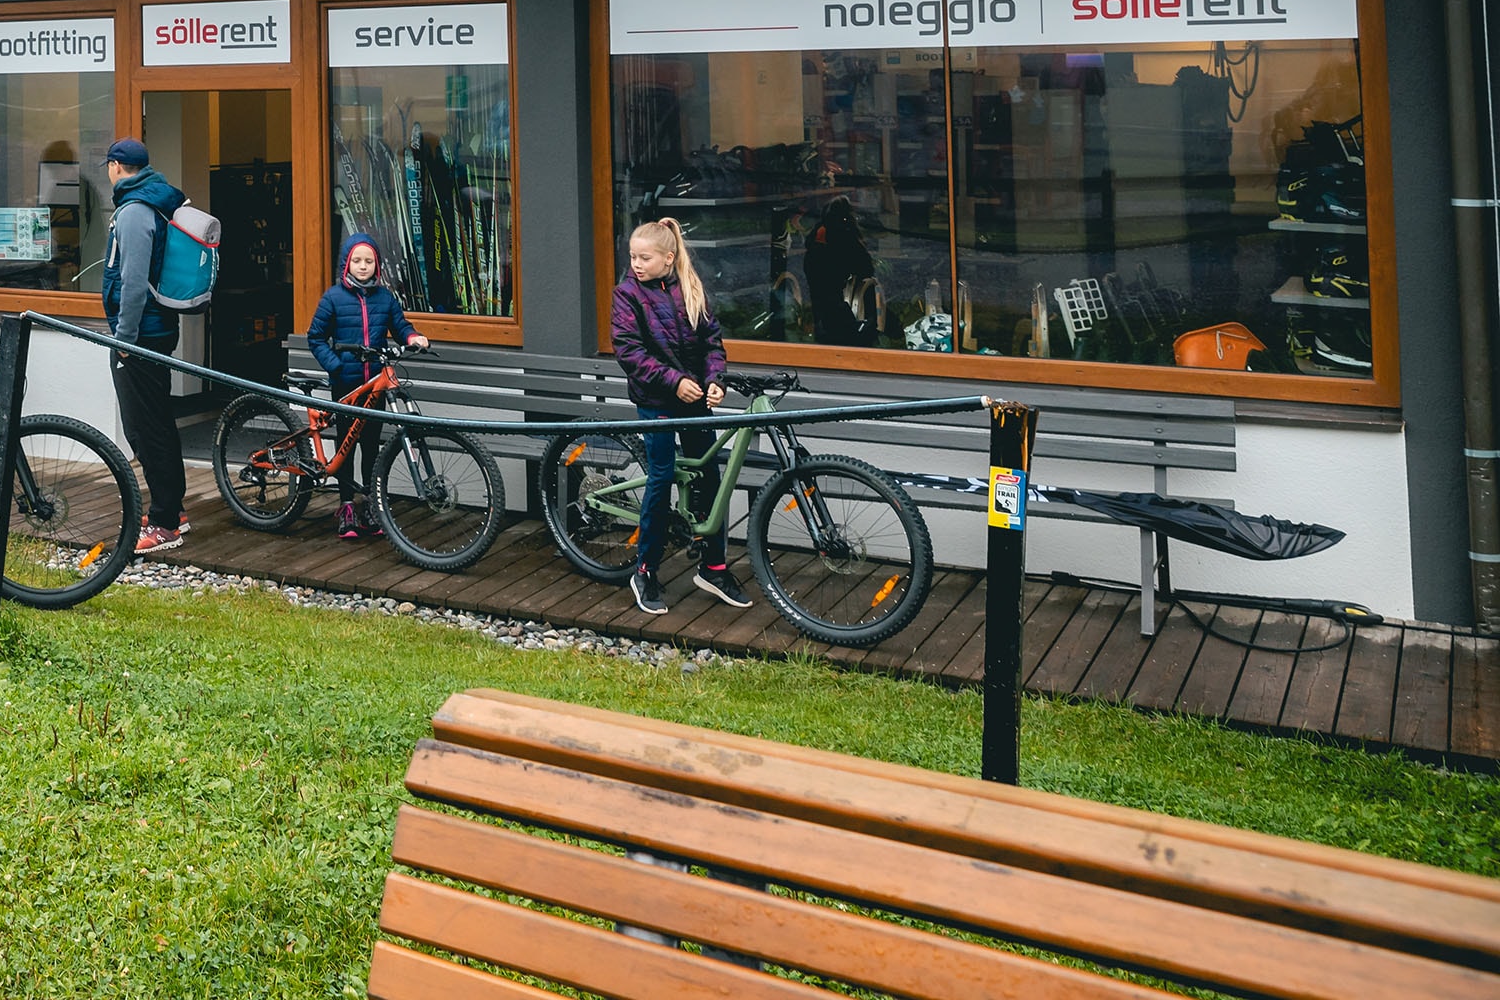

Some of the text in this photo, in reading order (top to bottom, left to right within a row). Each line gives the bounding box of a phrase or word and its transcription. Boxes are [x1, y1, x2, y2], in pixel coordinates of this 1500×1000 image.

[155, 15, 278, 47] söllerent
[354, 16, 475, 48] service
[407, 180, 422, 234] BRADOS
[433, 218, 442, 271] FISCHER
[997, 490, 1017, 499] TRAIL
[766, 583, 802, 620] KENDA
